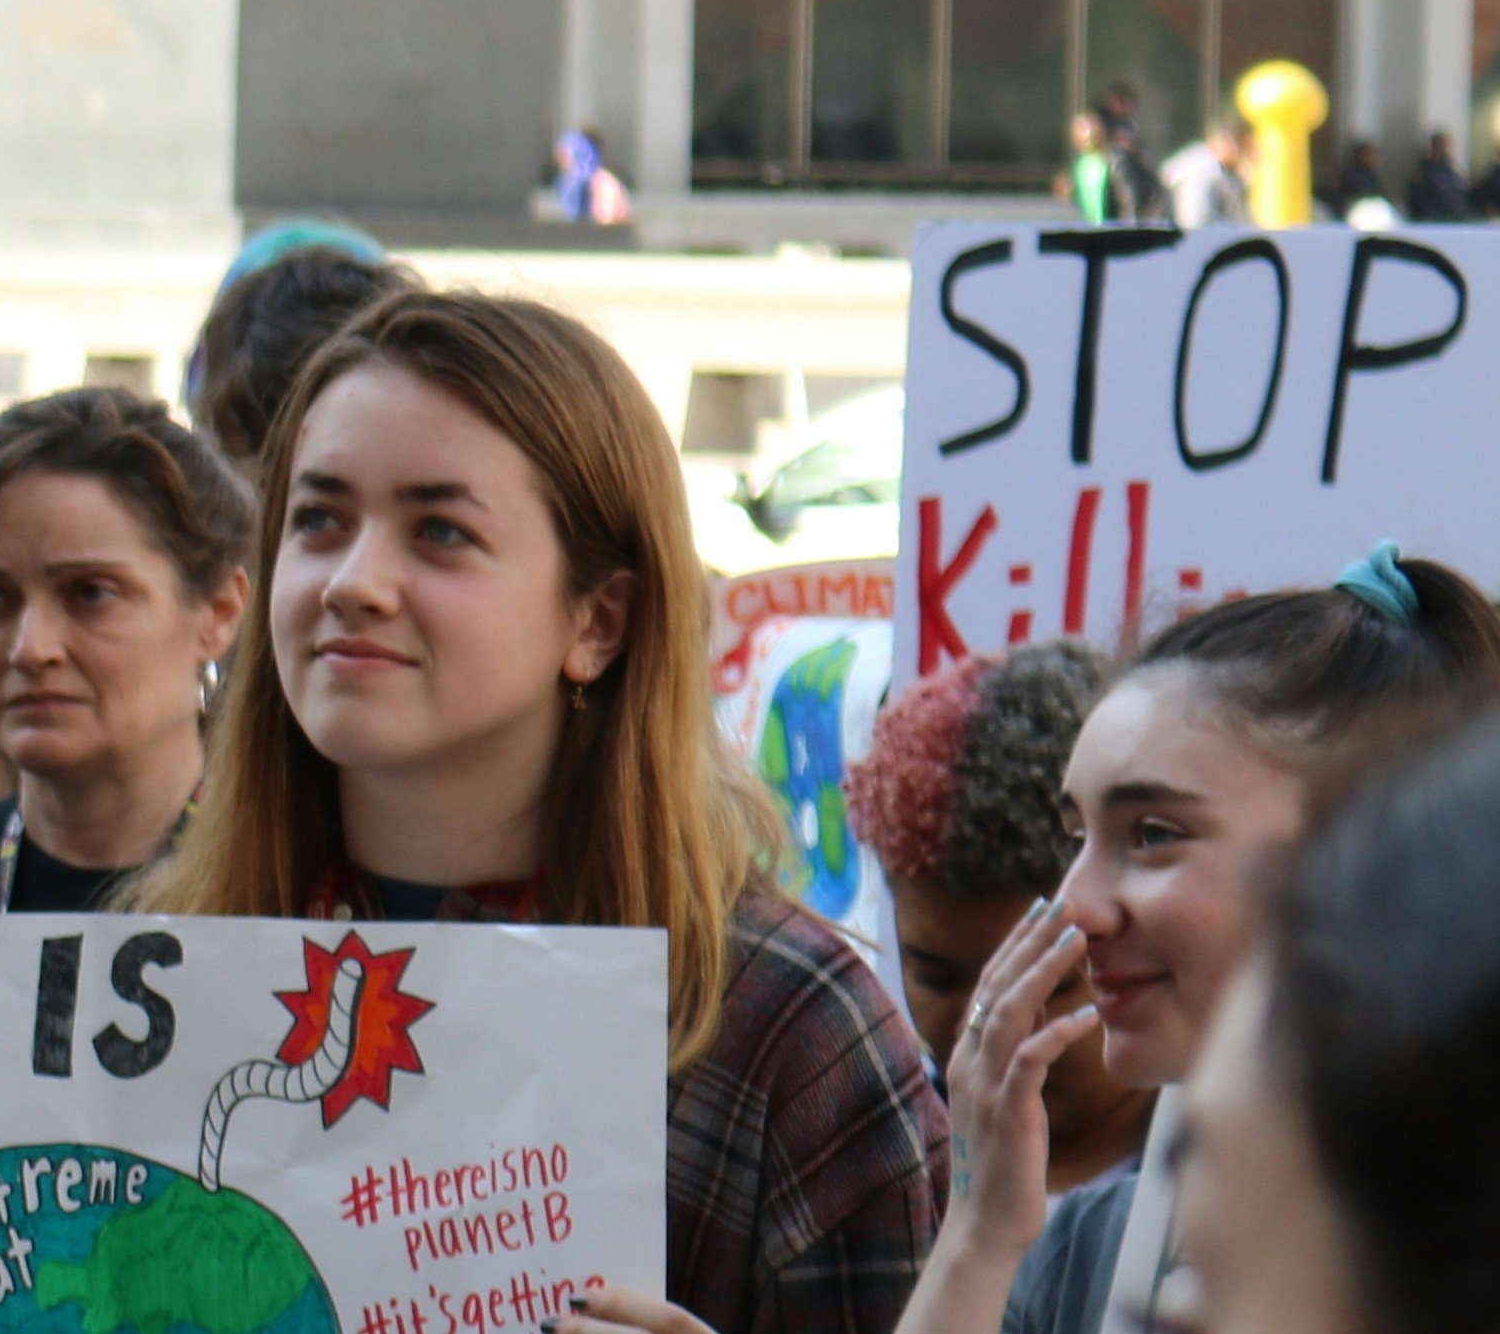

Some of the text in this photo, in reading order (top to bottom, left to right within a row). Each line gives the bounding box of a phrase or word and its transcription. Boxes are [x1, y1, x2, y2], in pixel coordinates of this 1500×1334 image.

[939, 225, 1469, 485] STOP
[917, 480, 1268, 677] Killi
[31, 932, 182, 1077] IS
[340, 1142, 569, 1227] #thereisno
